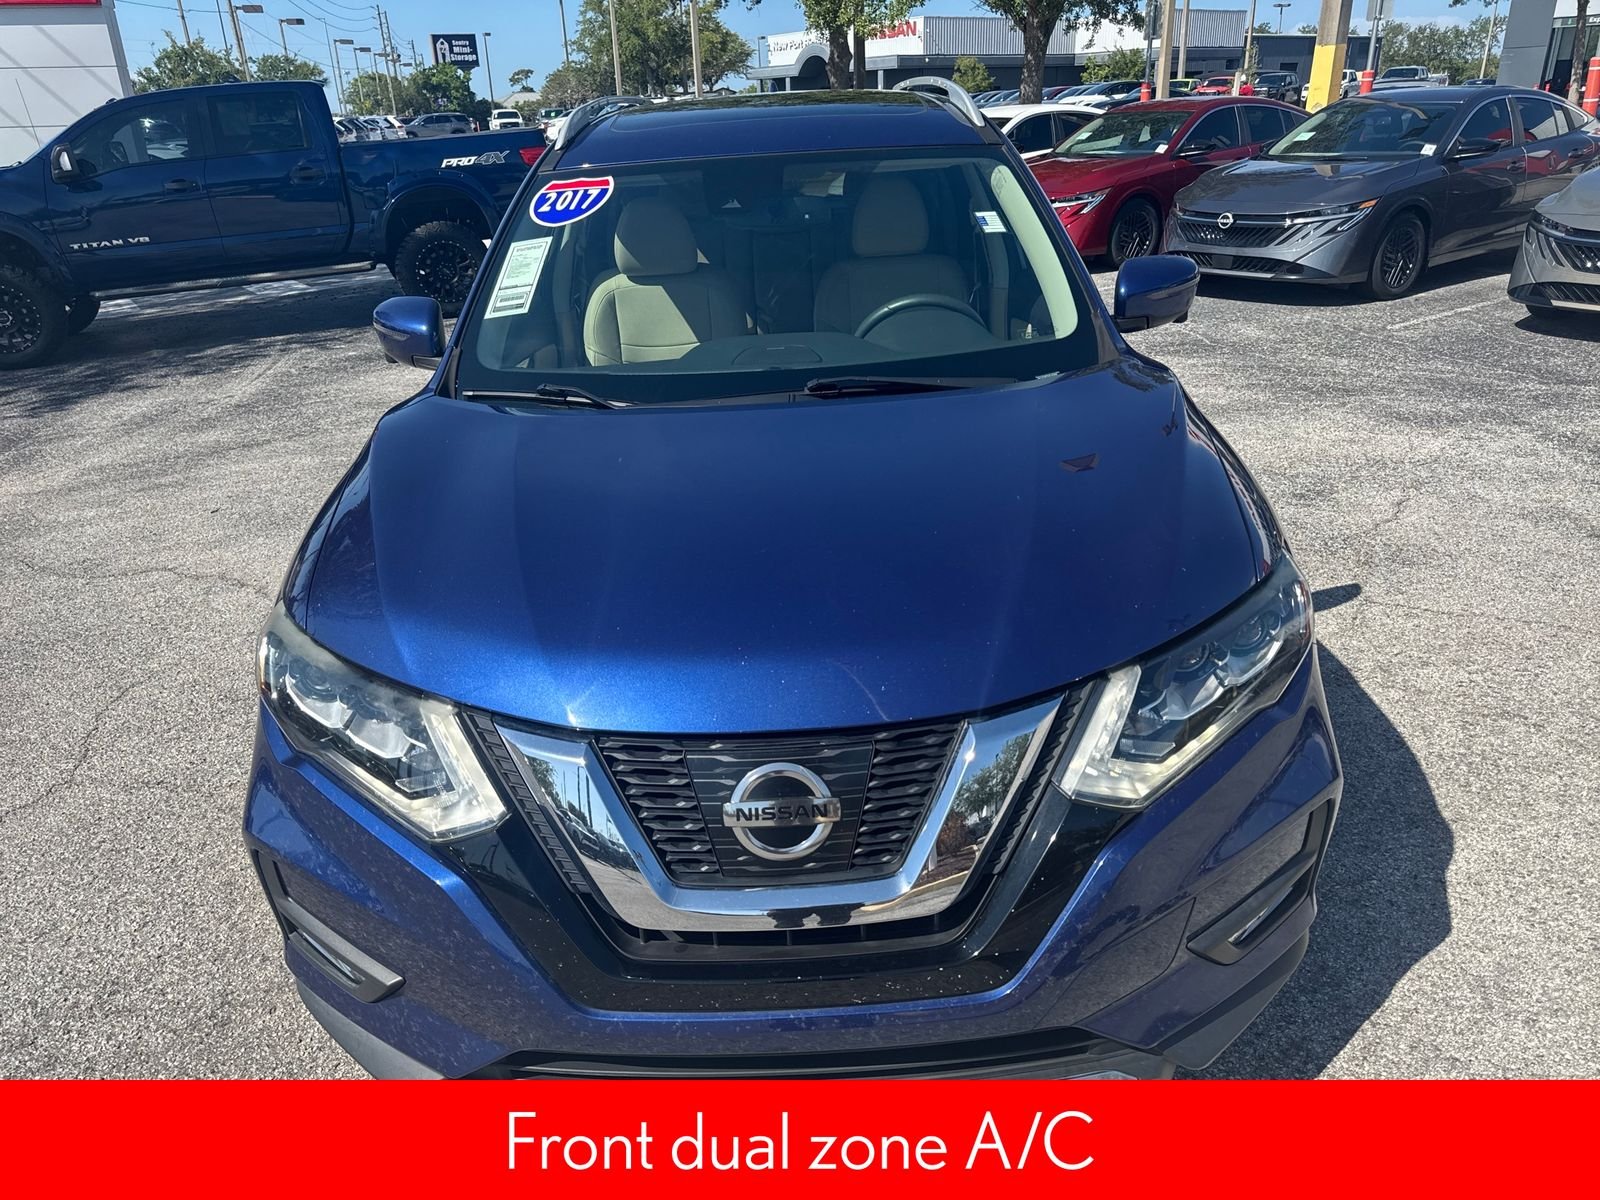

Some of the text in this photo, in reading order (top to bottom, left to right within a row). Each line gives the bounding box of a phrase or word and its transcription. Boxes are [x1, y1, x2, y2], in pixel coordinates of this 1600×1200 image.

[452, 46, 473, 54] Mini-
[450, 54, 477, 62] Storage
[537, 188, 602, 213] 2017
[69, 236, 150, 250] TITAN V8
[735, 803, 828, 822] NISSAN
